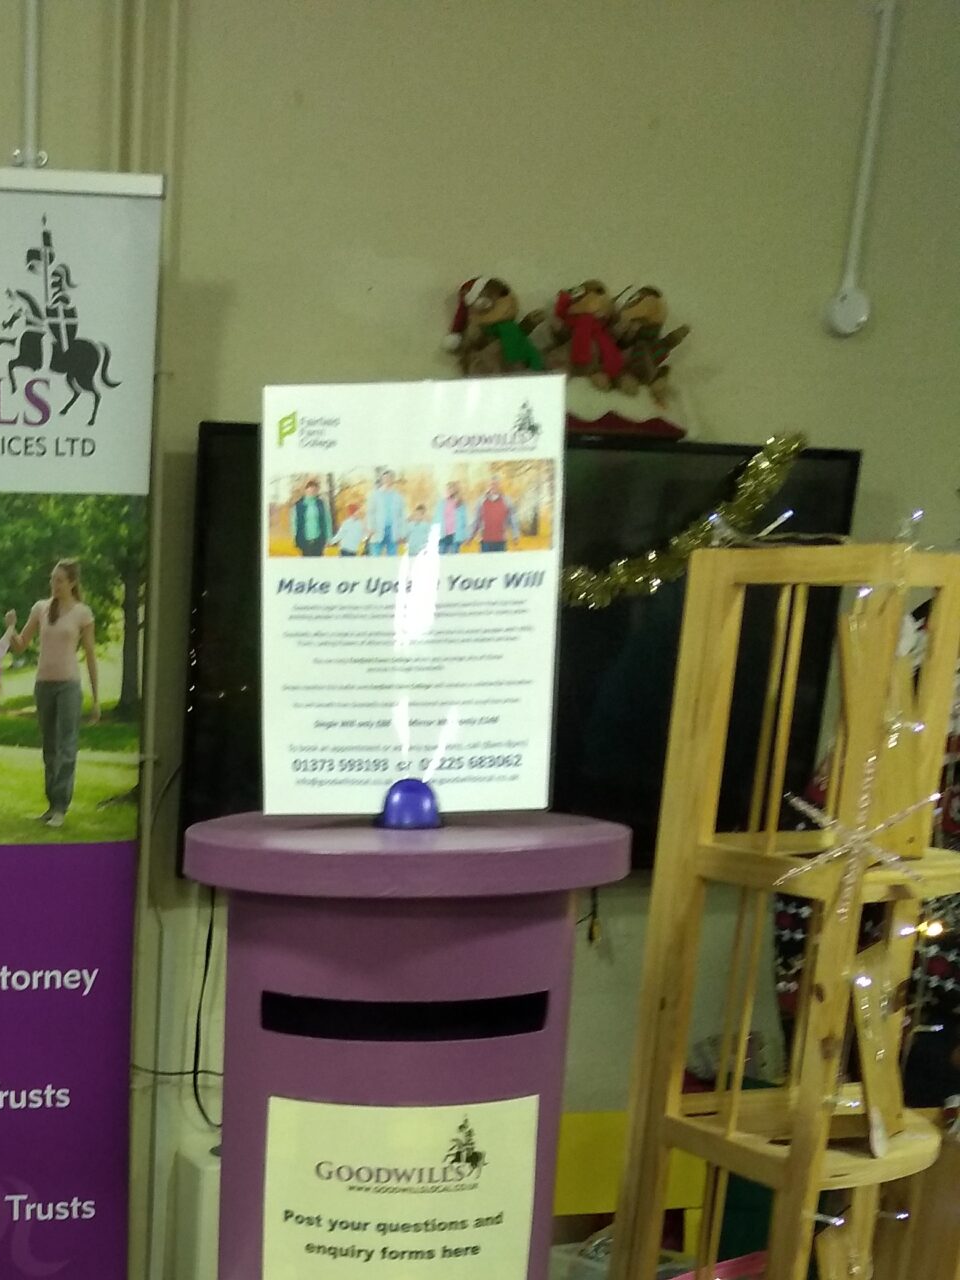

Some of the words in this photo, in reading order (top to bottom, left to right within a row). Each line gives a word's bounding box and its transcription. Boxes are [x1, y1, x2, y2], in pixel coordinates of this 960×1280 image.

[55, 437, 96, 457] LTD
[277, 578, 329, 594] Make
[336, 581, 356, 593] or
[448, 576, 497, 592] Your
[504, 571, 545, 588] Will
[292, 758, 335, 772] 01373
[419, 757, 464, 771] 0225
[315, 1160, 466, 1184] GOODWILLS
[4, 1194, 96, 1222] Trusts
[283, 1209, 322, 1228] Post
[328, 1218, 369, 1233] your
[375, 1217, 469, 1236] questions
[473, 1211, 504, 1228] and
[305, 1241, 375, 1263] enquiry
[380, 1246, 436, 1261] forms
[441, 1243, 481, 1258] here
